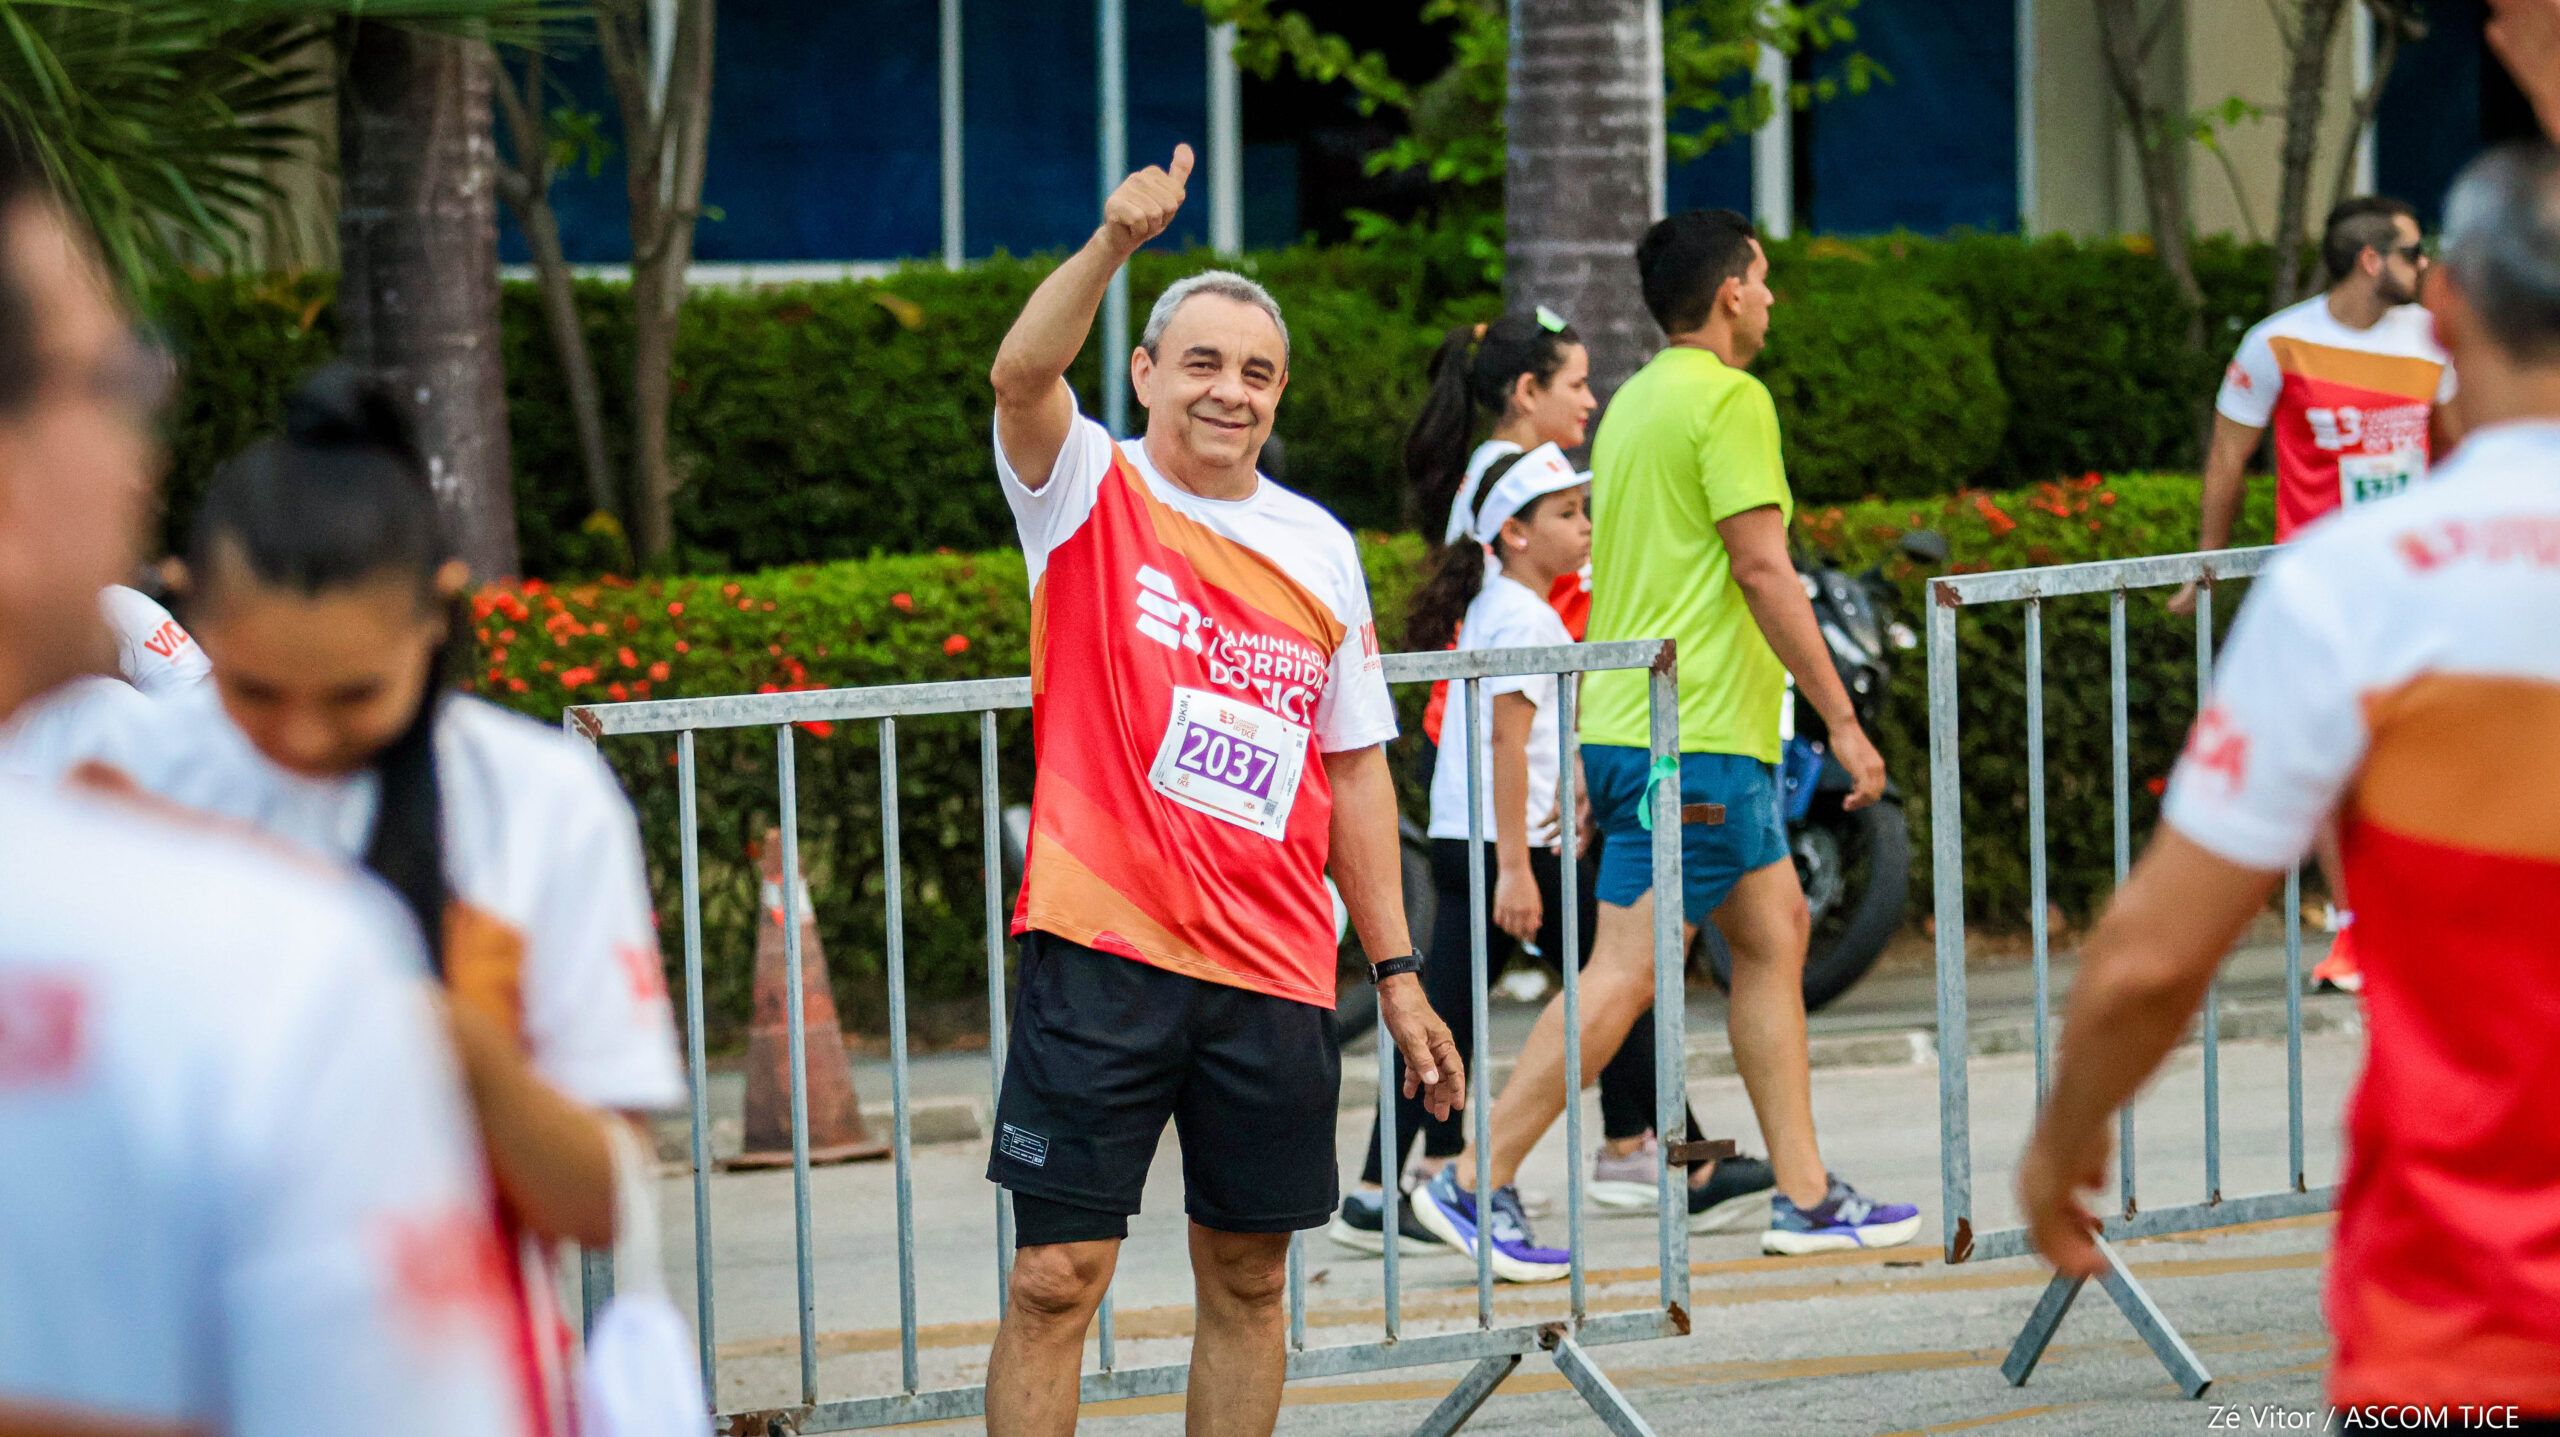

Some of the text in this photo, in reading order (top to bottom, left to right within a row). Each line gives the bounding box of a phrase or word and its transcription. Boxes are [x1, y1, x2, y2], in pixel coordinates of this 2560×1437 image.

[1209, 659, 1250, 690] DO
[1177, 700, 1189, 727] 10KM
[1179, 726, 1278, 792] 2037
